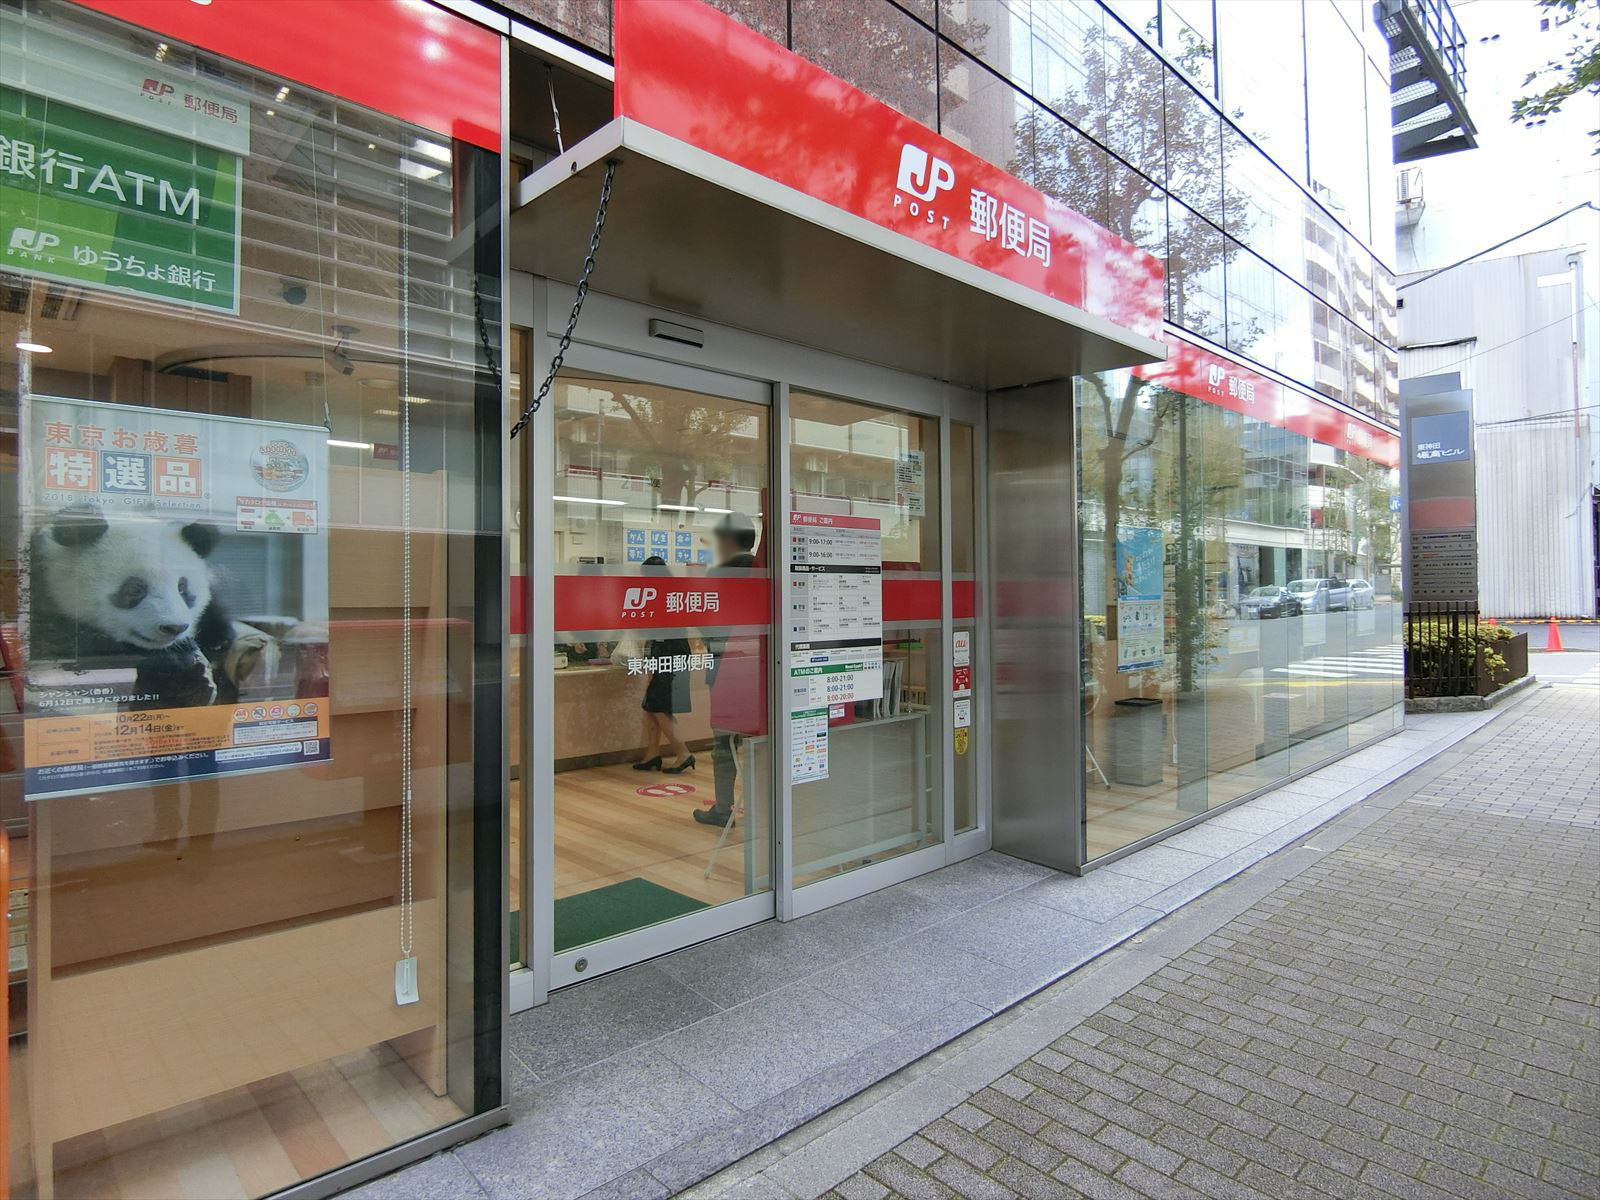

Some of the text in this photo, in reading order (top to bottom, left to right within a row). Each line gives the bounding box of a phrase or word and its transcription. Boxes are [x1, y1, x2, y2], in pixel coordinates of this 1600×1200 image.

[184, 94, 238, 123] 郵便局
[0, 134, 200, 220] 銀行ATM
[895, 143, 955, 202] JP
[893, 194, 950, 230] POST
[969, 188, 1052, 268] 郵便局
[73, 245, 216, 292] ゆうちょ銀行
[1228, 375, 1255, 404] 郵便局
[45, 421, 199, 455] 東京お歳暮
[48, 451, 197, 494] 特選品
[44, 493, 73, 502] 2018
[83, 495, 115, 507] Tokyo
[156, 498, 201, 510] Selection
[623, 587, 658, 610] JP
[665, 591, 720, 614] 郵便局
[621, 611, 655, 619] POST
[626, 653, 715, 676] 東神田郵便局
[826, 674, 854, 684] 8:00-21:00
[826, 683, 854, 693] 8:00-21:00
[827, 692, 855, 702] 8:00-20:00
